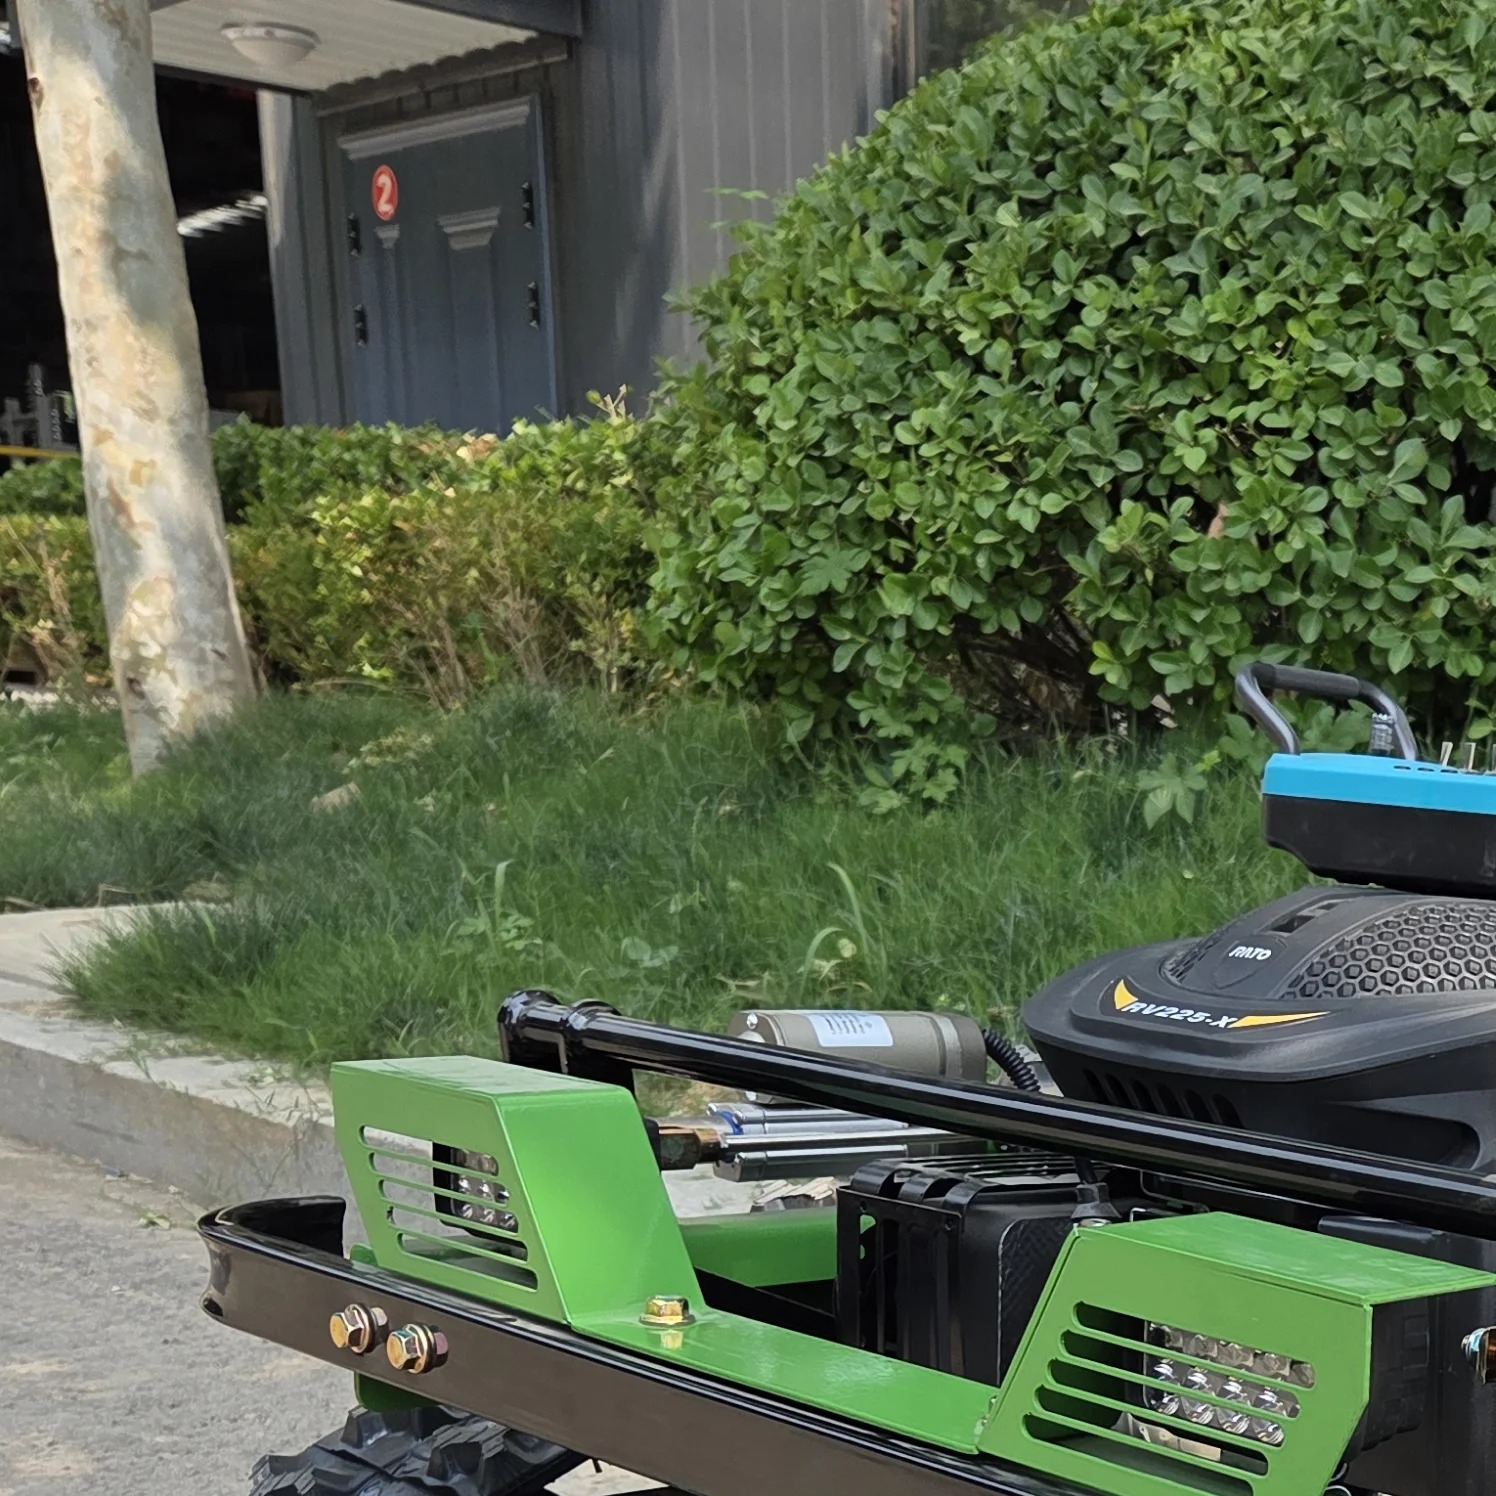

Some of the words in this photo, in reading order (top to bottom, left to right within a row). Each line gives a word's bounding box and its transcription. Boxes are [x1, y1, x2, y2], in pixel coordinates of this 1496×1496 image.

[376, 173, 394, 213] 2
[1228, 945, 1272, 961] RATO
[1120, 1001, 1239, 1029] RV225-X
